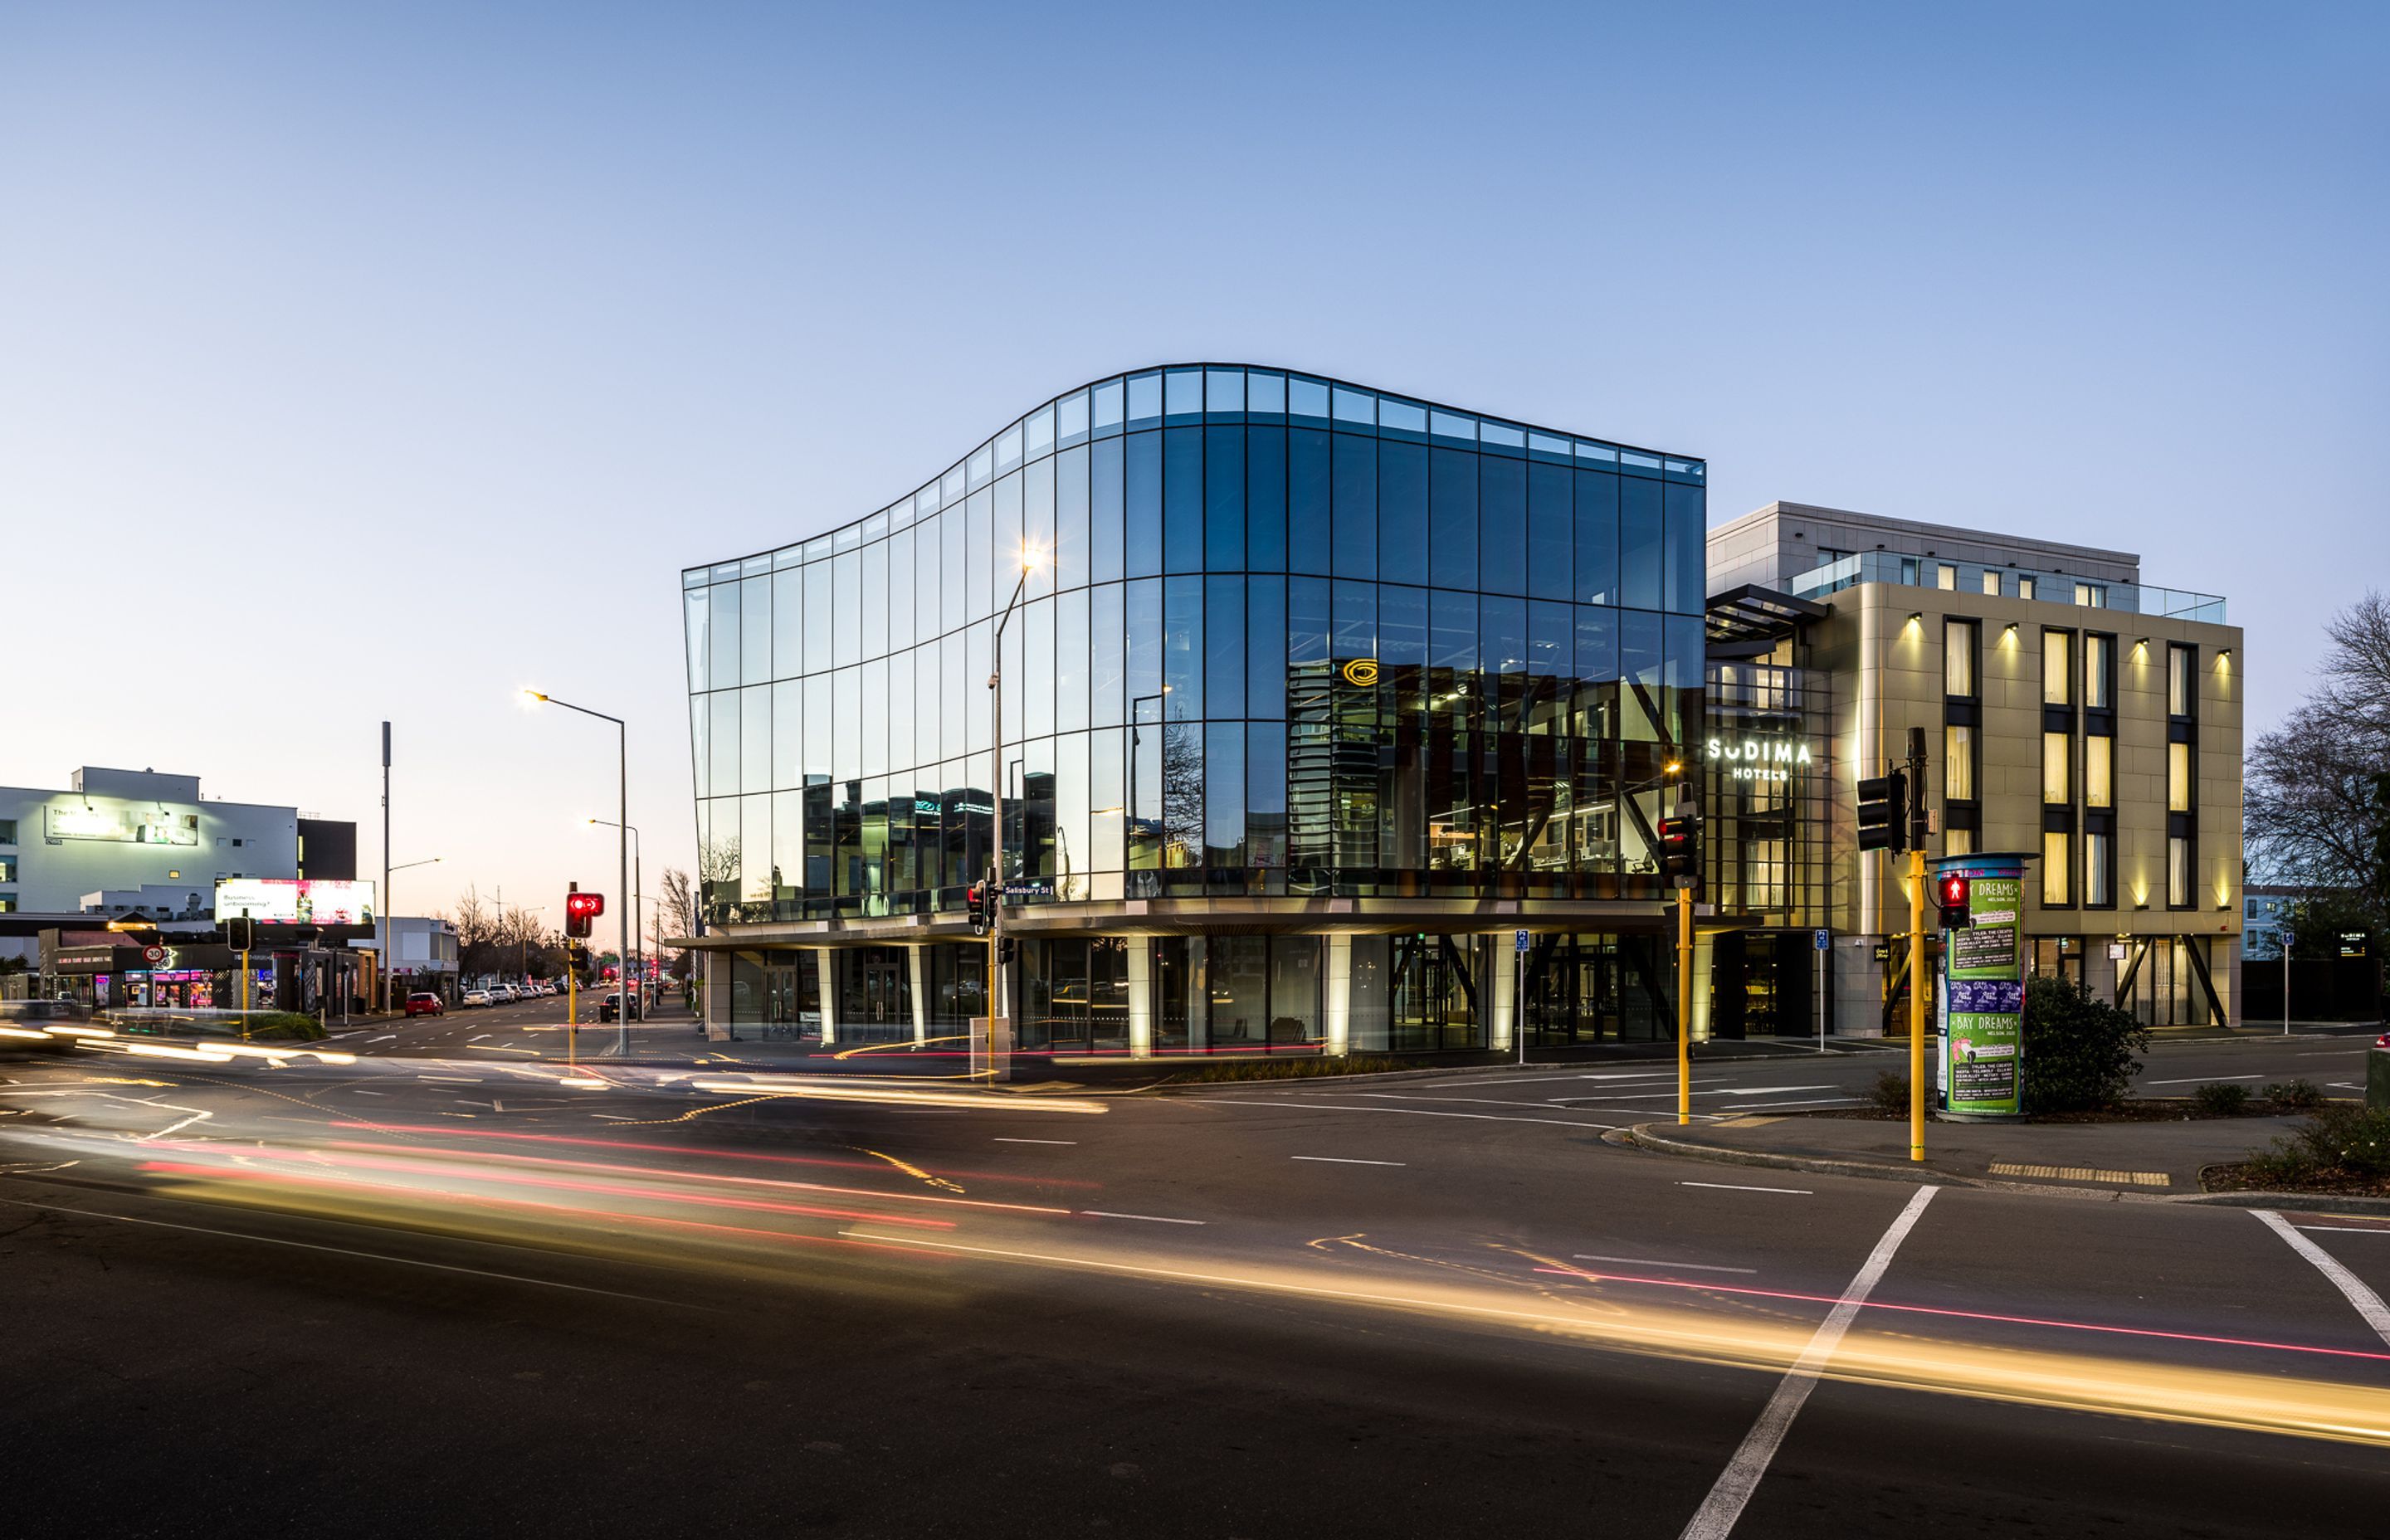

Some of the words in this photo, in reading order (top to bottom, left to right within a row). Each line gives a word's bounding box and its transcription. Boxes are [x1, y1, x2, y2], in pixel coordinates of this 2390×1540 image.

[1733, 768, 1788, 782] HOTELS
[1005, 886, 1039, 895] Salisbury
[1978, 882, 2014, 896] DREAMS
[1957, 1016, 1973, 1030] BAY
[1978, 1016, 2013, 1030] DREAMS
